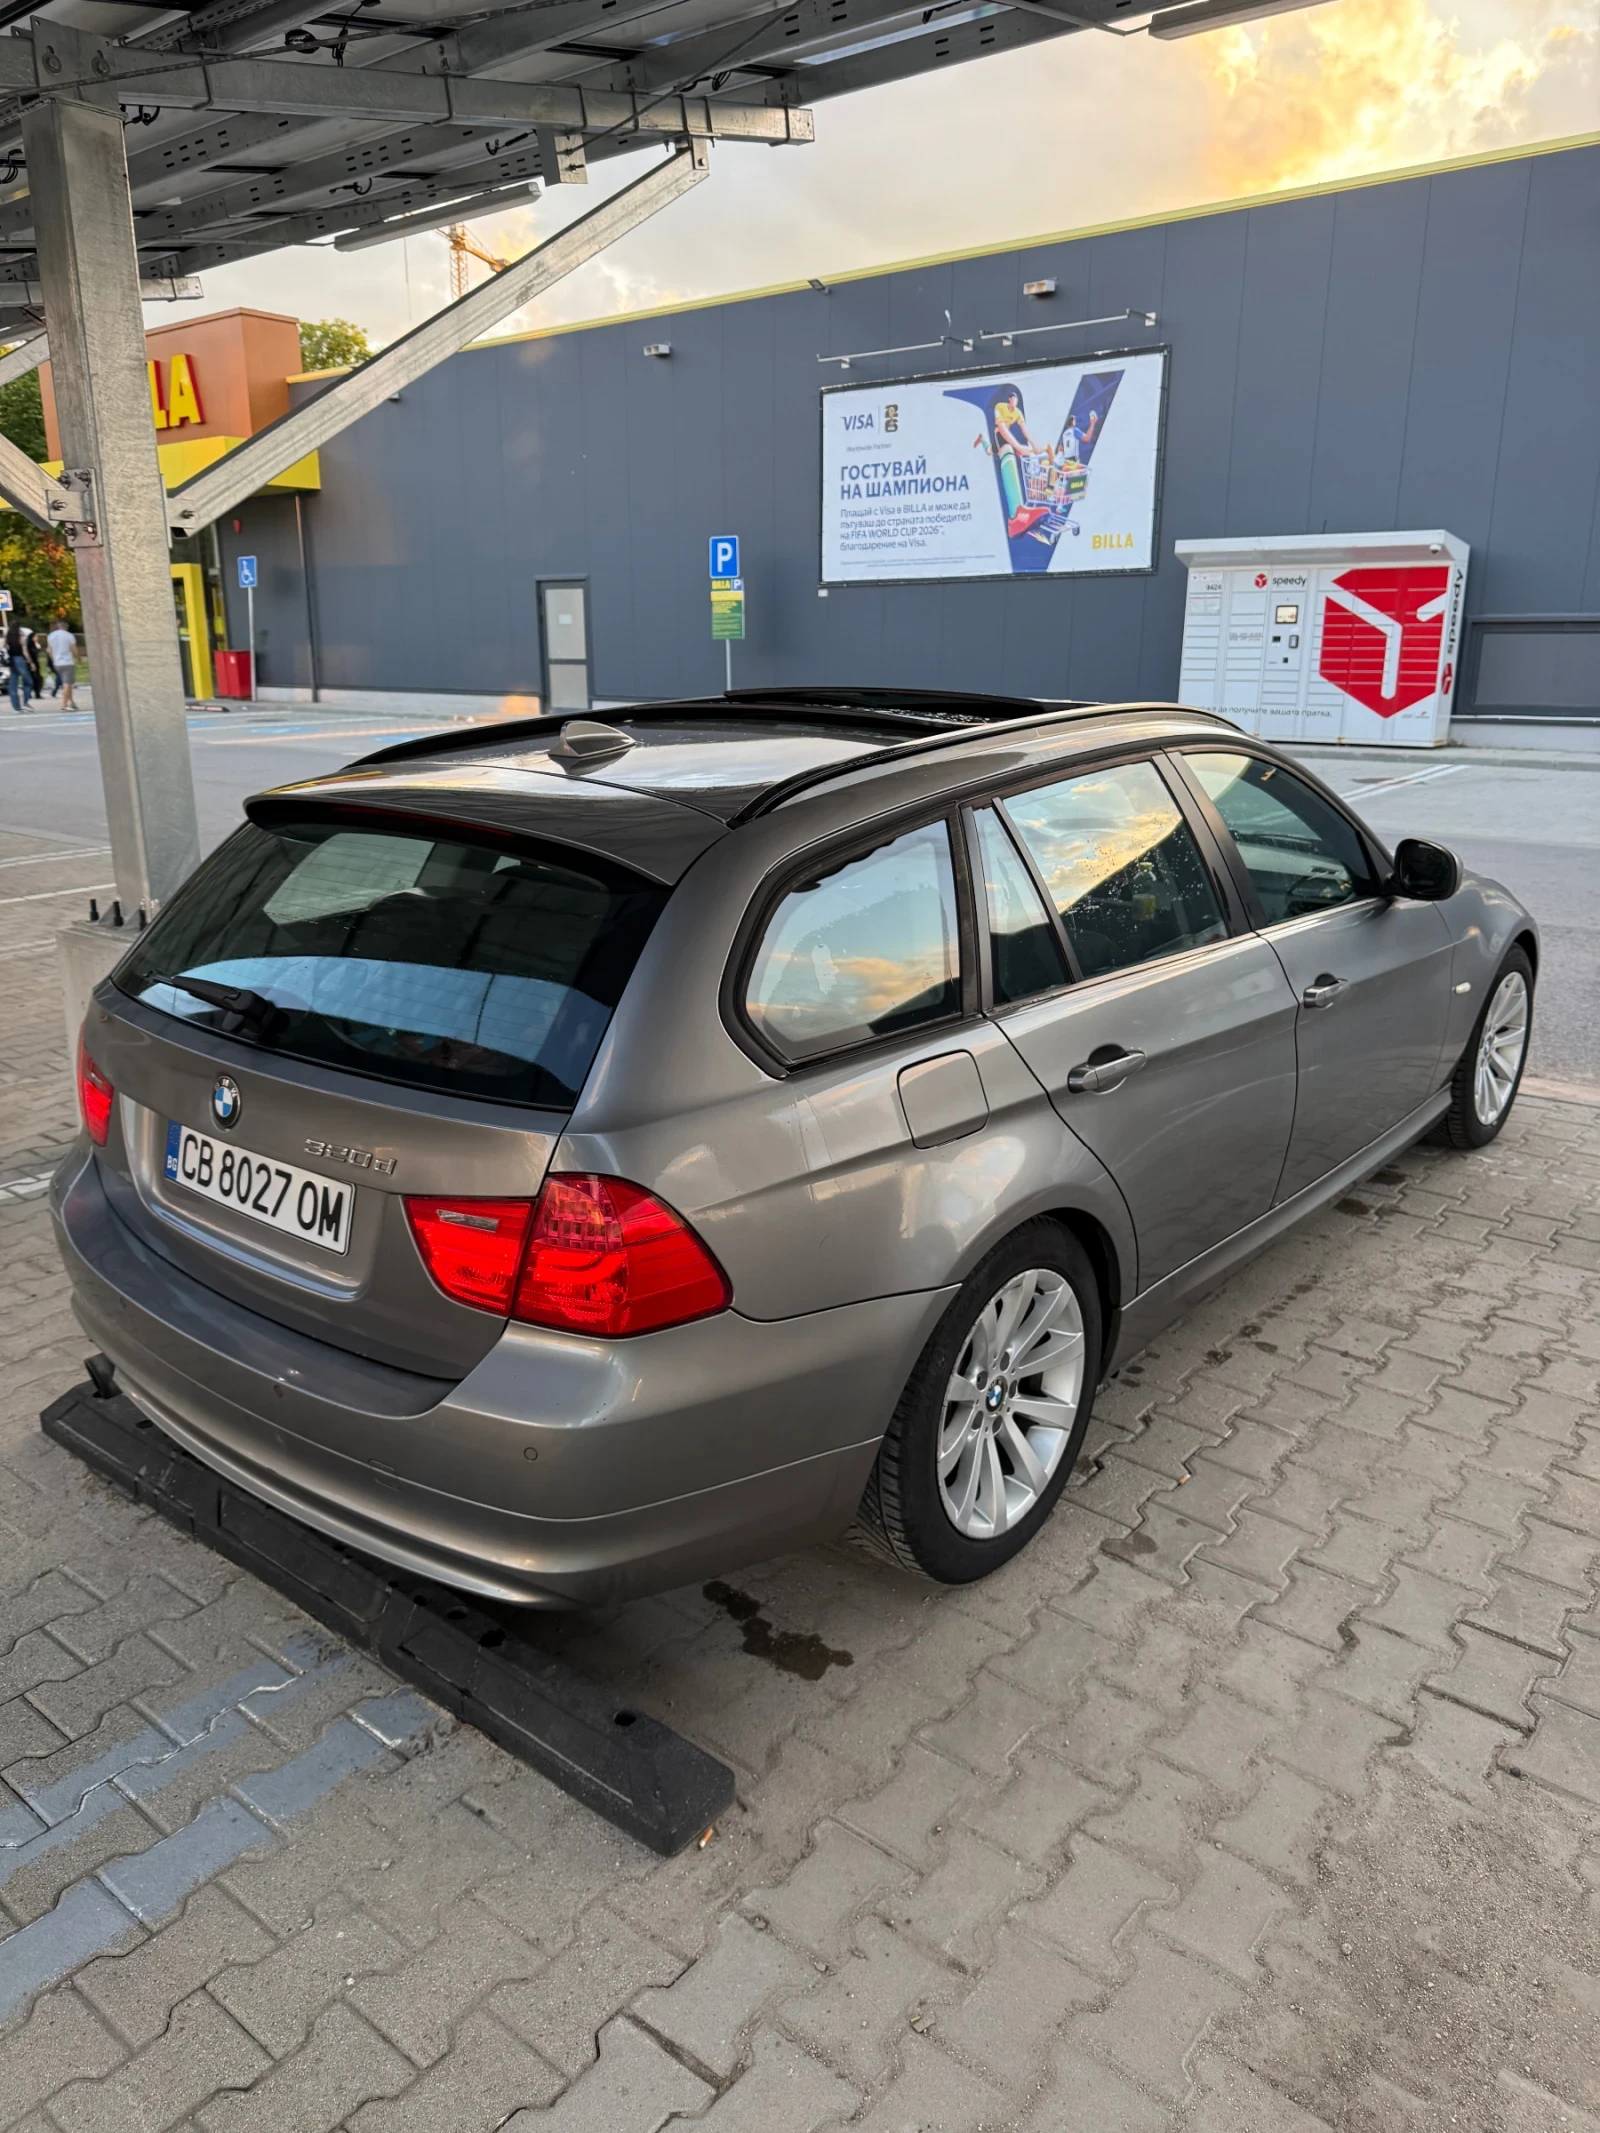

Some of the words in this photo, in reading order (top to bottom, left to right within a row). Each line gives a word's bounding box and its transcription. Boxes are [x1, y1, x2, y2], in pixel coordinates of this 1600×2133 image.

[841, 413, 874, 431] VISA
[841, 455, 926, 481] ГОСТУВАЙ
[841, 483, 862, 500] НА
[866, 475, 970, 498] ШАМПИОНА
[841, 507, 872, 518] Плащай
[903, 504, 927, 513] BILLA
[925, 513, 972, 524] победител
[851, 529, 867, 540] FIFA
[868, 528, 899, 538] WORLD
[900, 527, 918, 536] CUP
[1091, 533, 1134, 549] BILLA
[716, 542, 733, 572] P
[1272, 576, 1307, 587] speedy
[166, 1155, 178, 1172] BG
[182, 1133, 214, 1188] CB
[219, 1150, 292, 1218] 8027
[297, 1180, 344, 1243] OM
